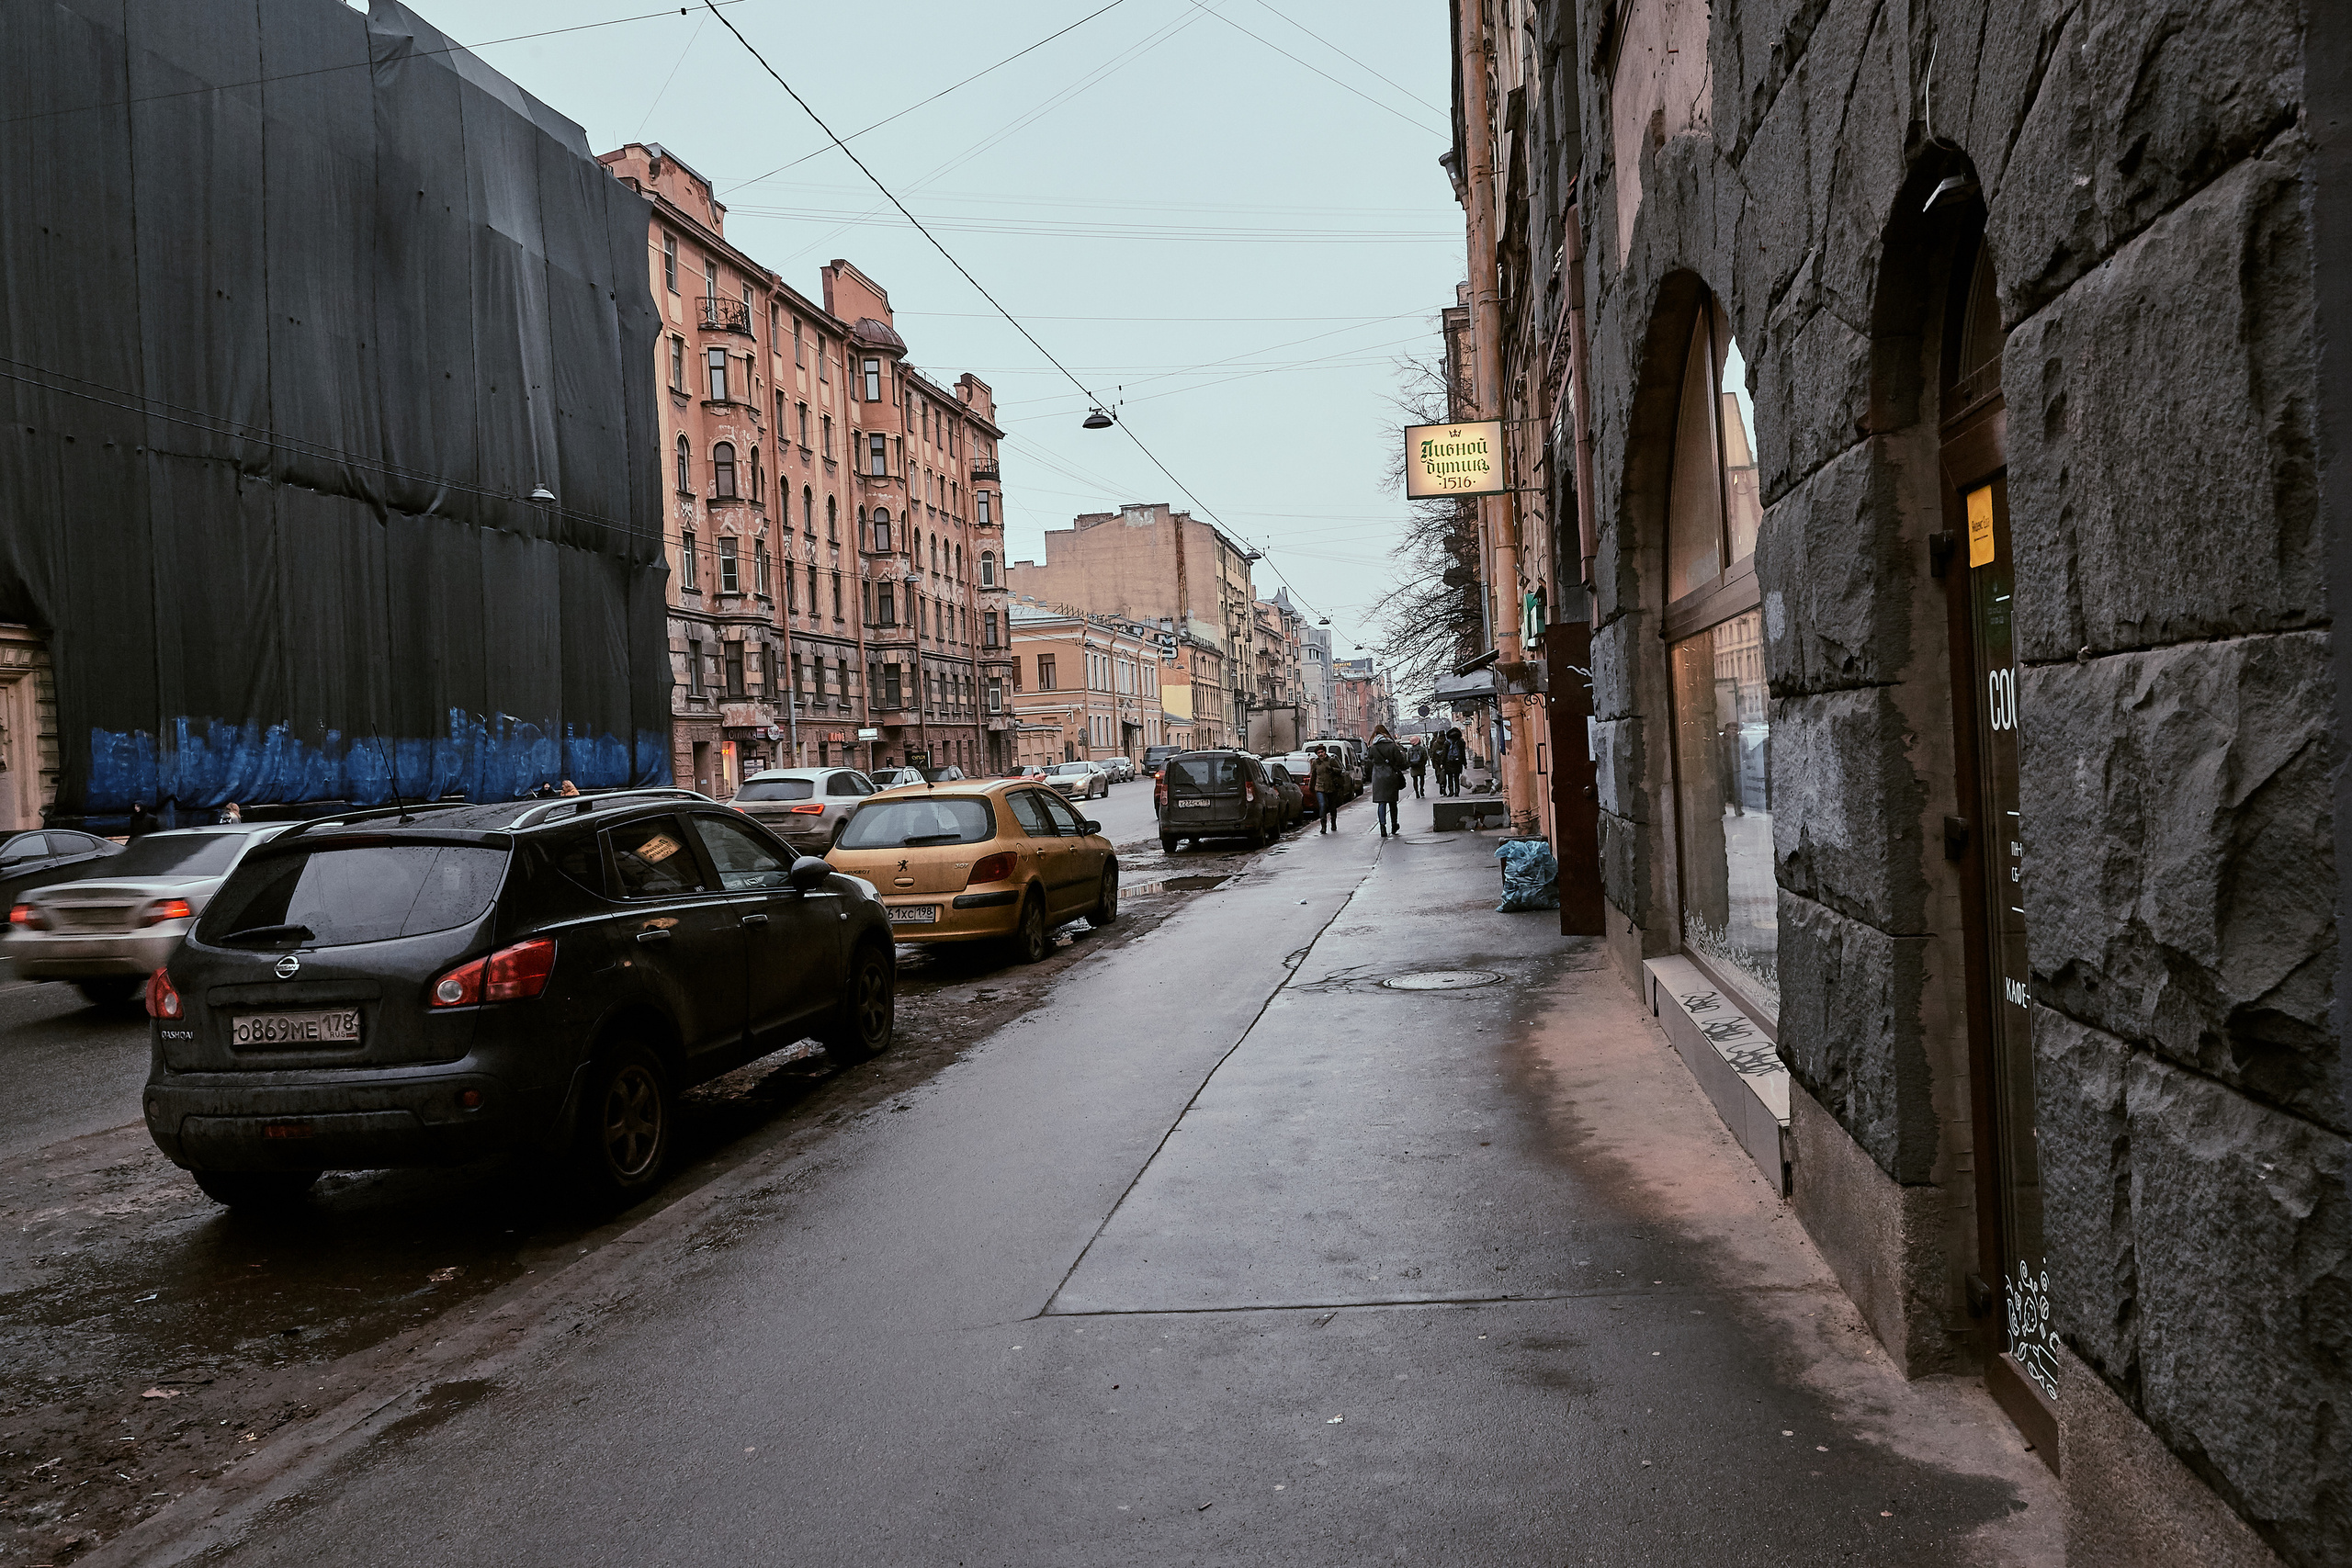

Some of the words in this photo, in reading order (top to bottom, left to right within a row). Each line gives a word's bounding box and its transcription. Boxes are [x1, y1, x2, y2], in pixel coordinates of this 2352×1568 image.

[1420, 437, 1488, 463] Пивной
[917, 907, 933, 916] 198
[237, 1017, 319, 1042] О869МЕ
[322, 1013, 355, 1031] 178
[162, 1029, 194, 1041] QASHQAI
[330, 1031, 346, 1039] RUS
